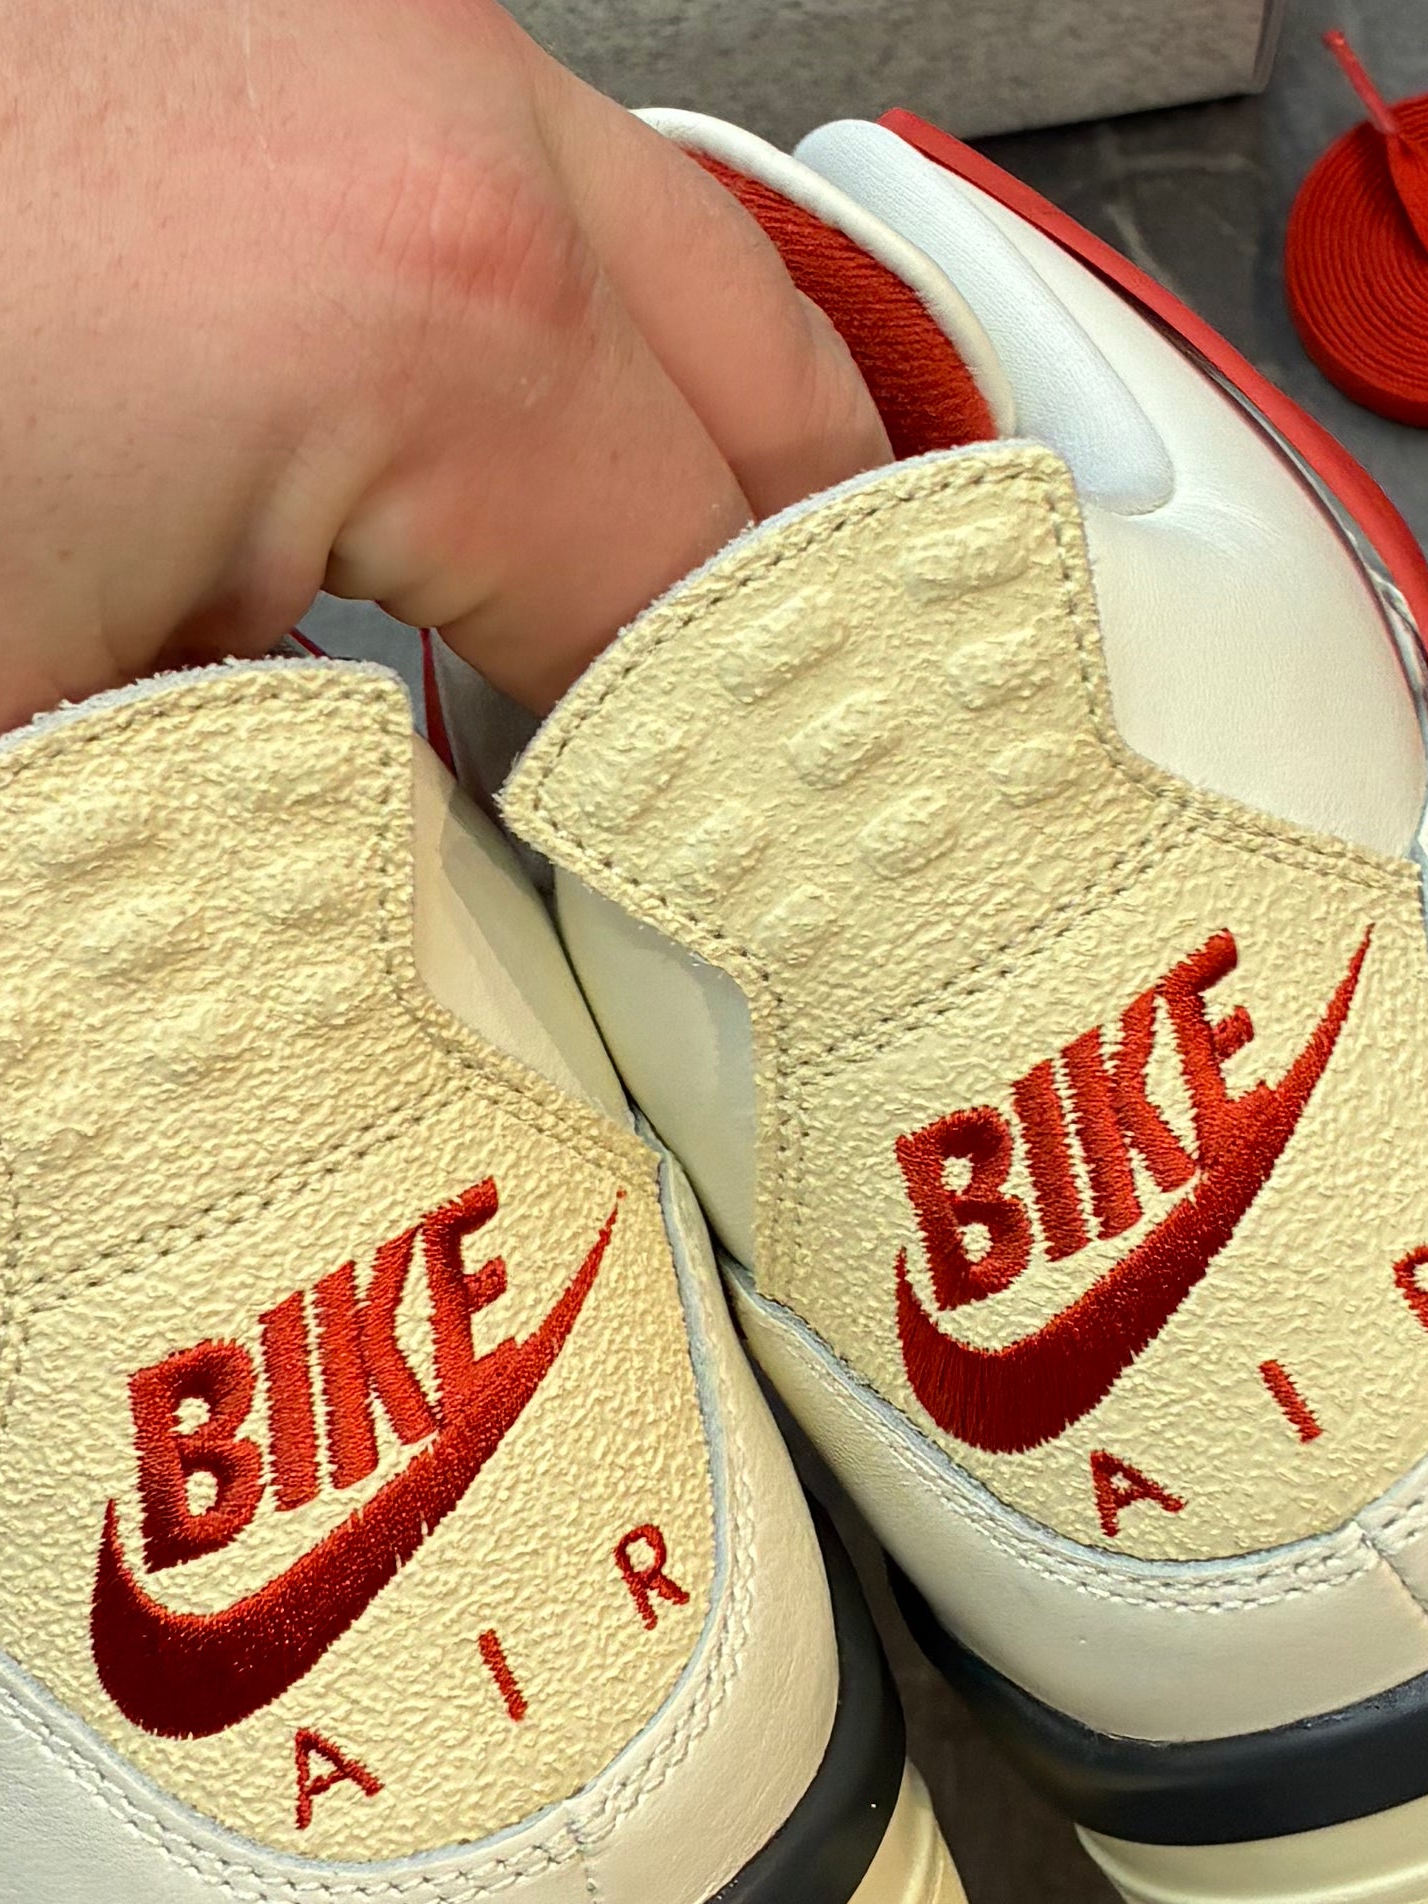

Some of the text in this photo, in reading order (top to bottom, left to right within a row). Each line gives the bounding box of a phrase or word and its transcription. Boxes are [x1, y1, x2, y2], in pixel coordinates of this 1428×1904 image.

[894, 928, 1274, 1311] BIKE
[127, 1176, 520, 1572] BIKE
[294, 1523, 690, 1830] AIR
